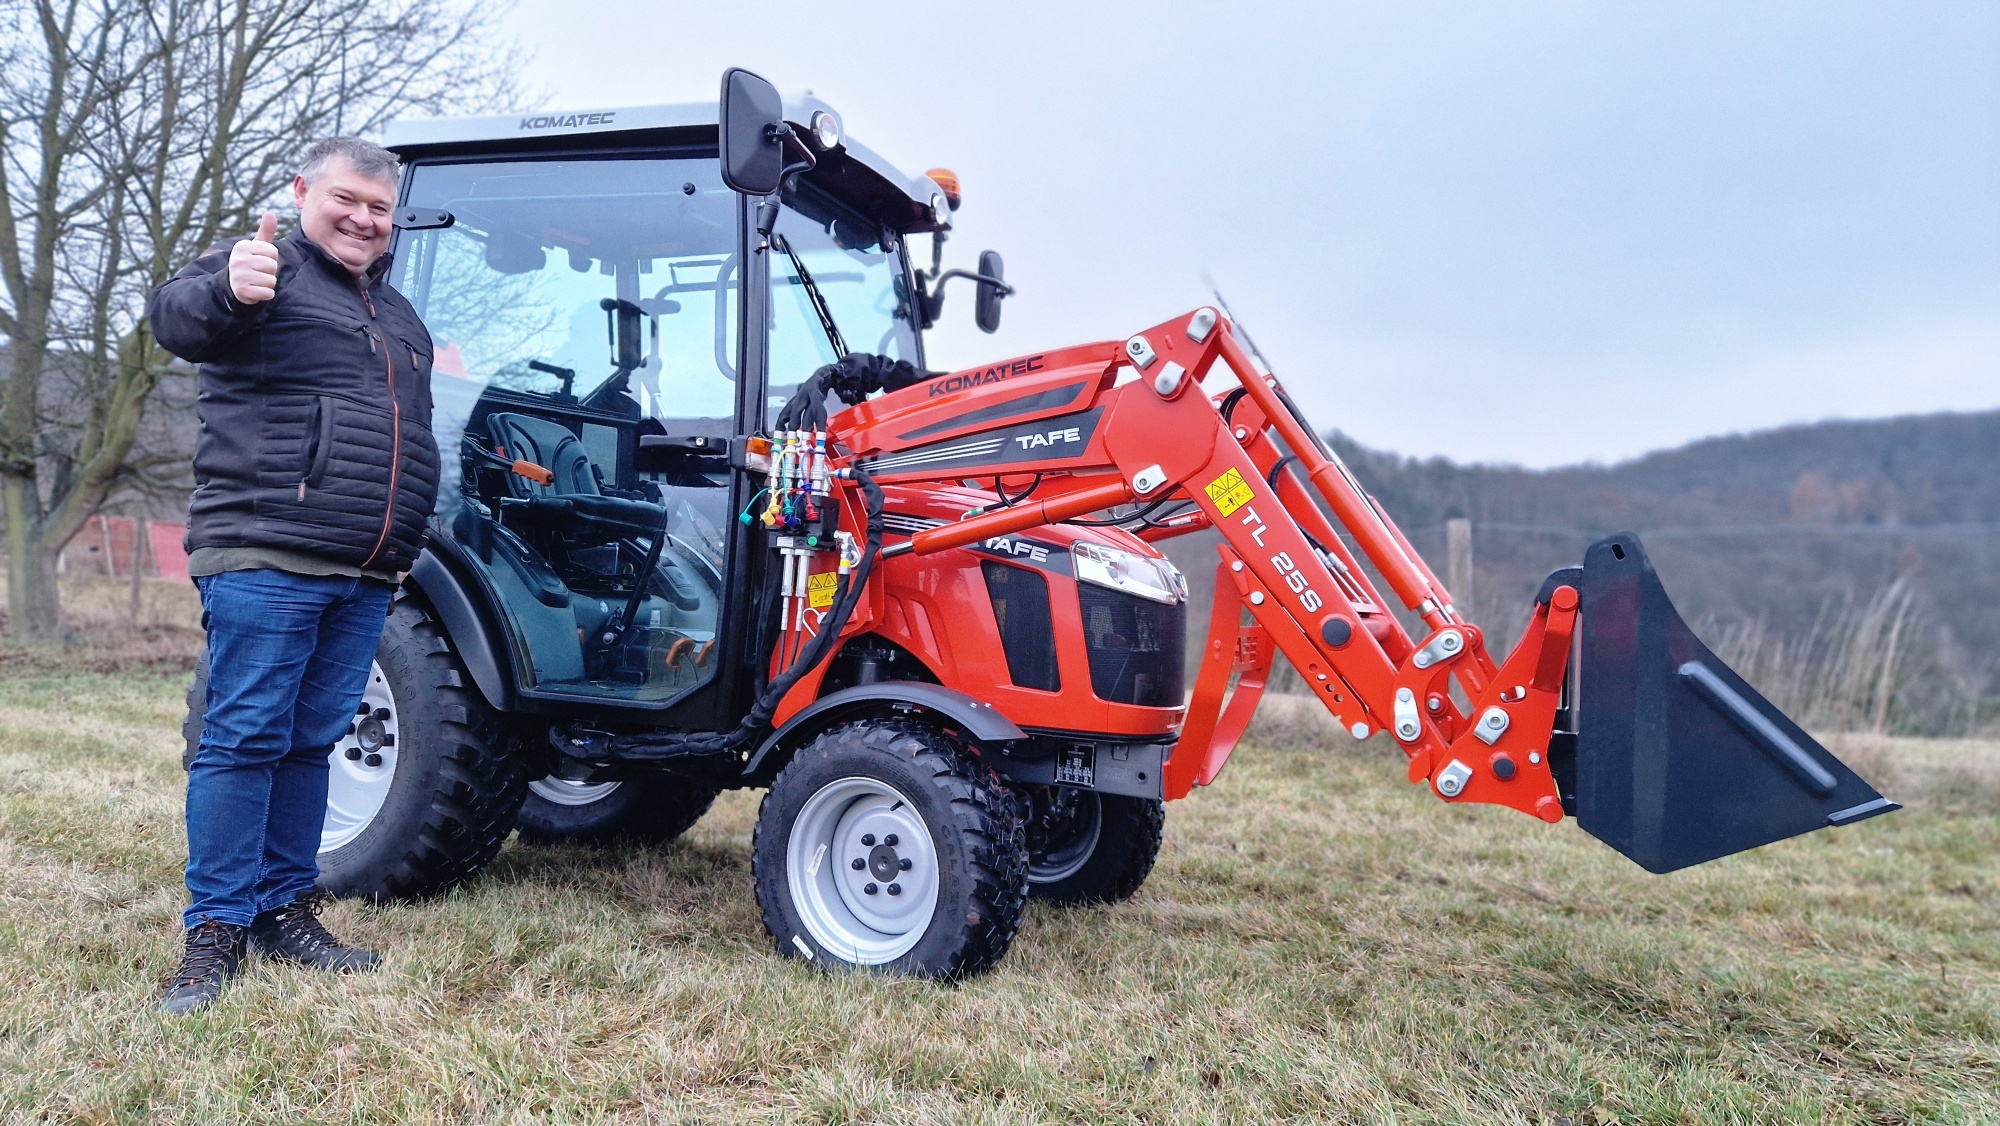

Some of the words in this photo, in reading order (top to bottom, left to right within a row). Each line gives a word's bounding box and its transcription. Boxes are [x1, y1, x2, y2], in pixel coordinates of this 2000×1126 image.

[519, 112, 616, 130] KOMATEC
[928, 355, 1044, 398] KOMATEC
[1015, 427, 1081, 450] TAFE
[984, 536, 1049, 563] TAFE
[1241, 505, 1268, 548] TL
[1270, 551, 1324, 613] 25S
